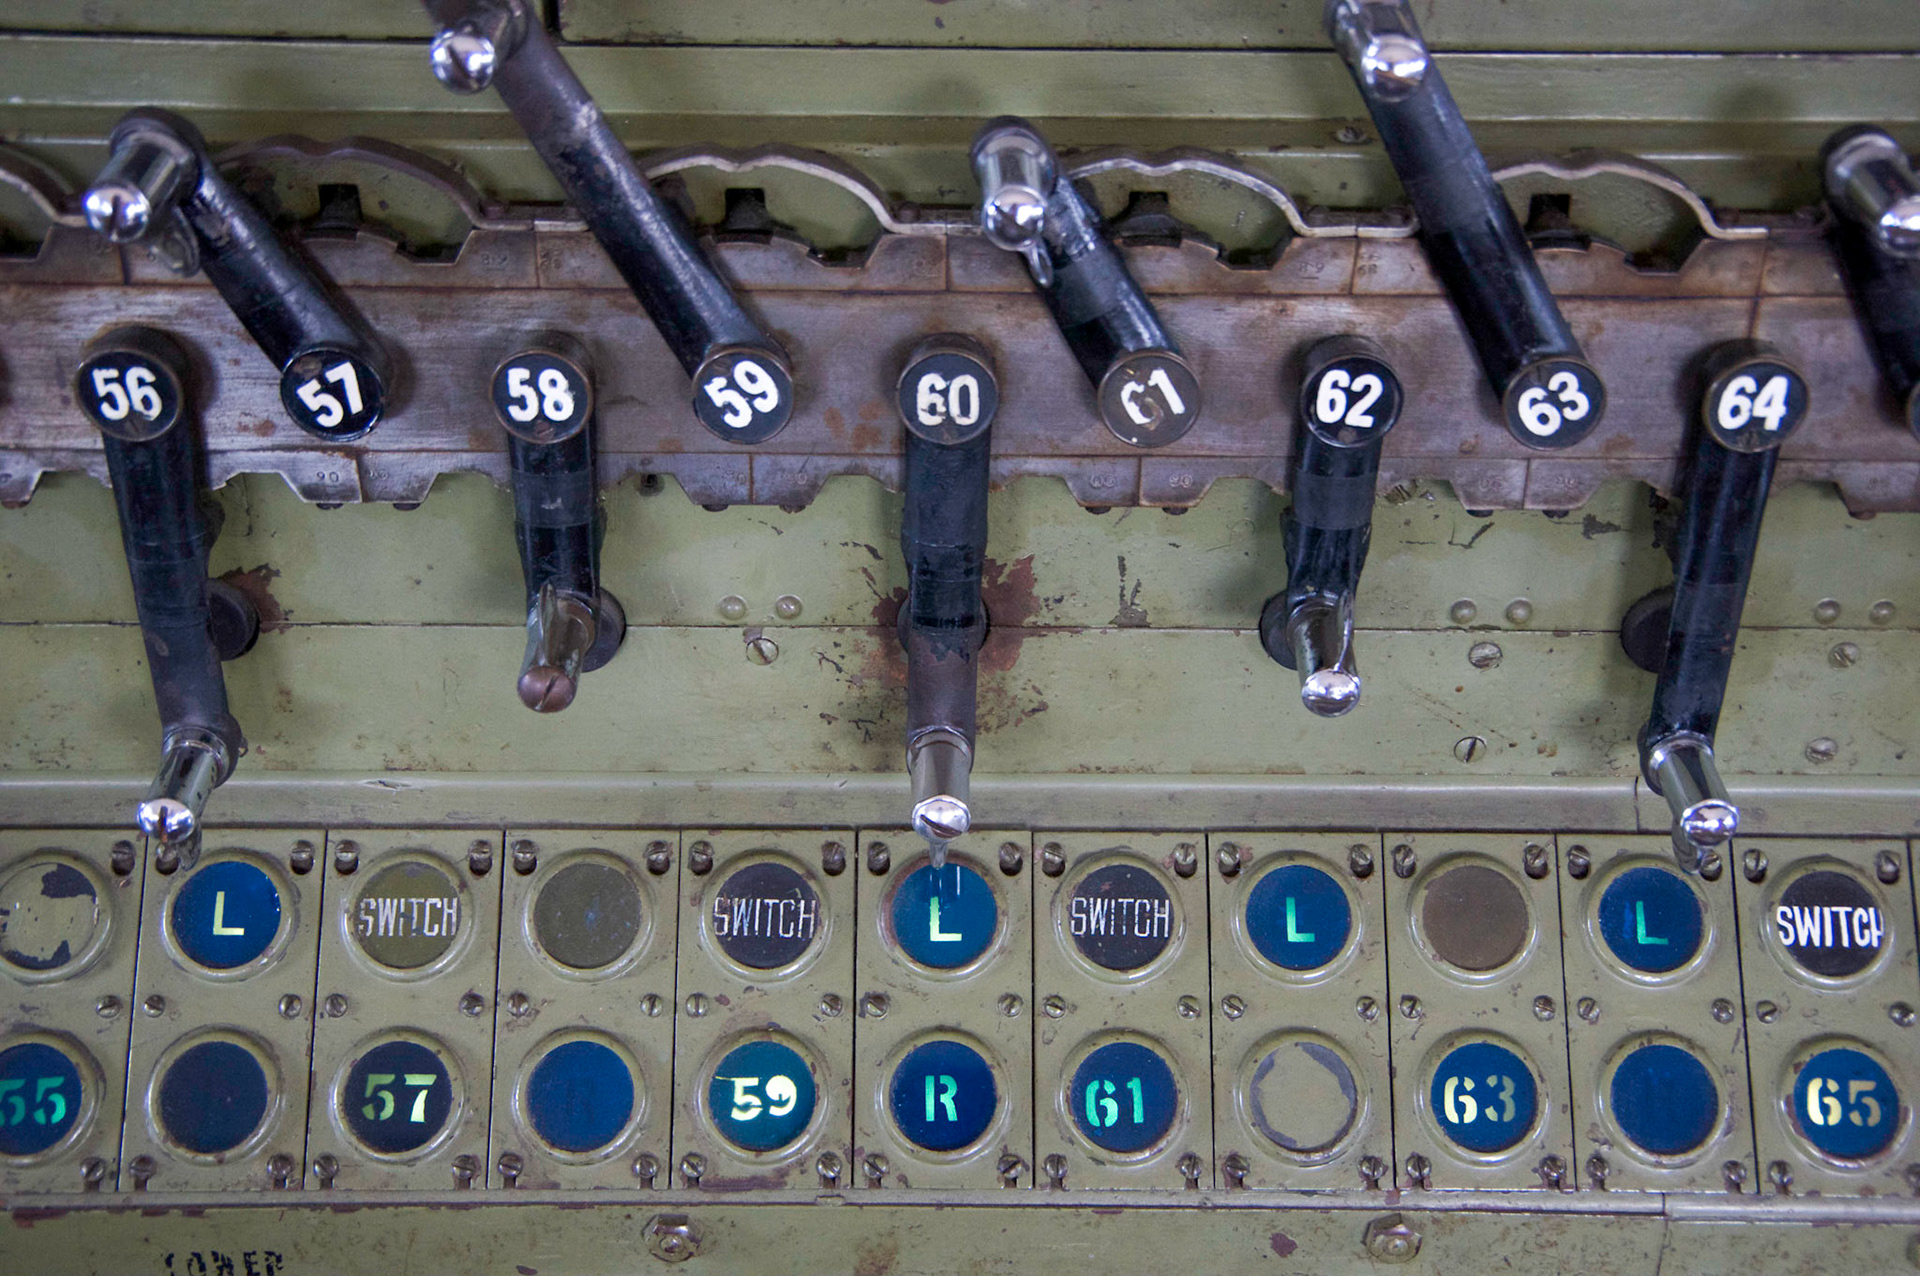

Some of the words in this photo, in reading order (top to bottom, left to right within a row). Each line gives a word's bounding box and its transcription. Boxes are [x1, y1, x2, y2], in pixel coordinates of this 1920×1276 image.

[93, 367, 162, 421] 56
[297, 361, 363, 427] 57
[507, 367, 575, 422] 58
[704, 361, 779, 428] 59
[916, 372, 980, 426] 60
[1120, 368, 1186, 425] 61
[1316, 369, 1384, 428] 62
[1518, 372, 1590, 437] 63
[1717, 375, 1789, 431] 64
[212, 891, 245, 936] L
[359, 897, 458, 937] SWITCH
[713, 896, 817, 939] SWITCH
[929, 896, 962, 942] L
[1070, 896, 1171, 938] SWITCH
[1286, 897, 1315, 943] L
[1635, 900, 1668, 945] L
[1776, 905, 1885, 949] SWITCH
[0, 1076, 66, 1125] 55
[361, 1073, 437, 1123] 57
[730, 1074, 798, 1122] 59
[925, 1074, 958, 1122] R
[1085, 1077, 1144, 1128] 61
[1444, 1076, 1516, 1124] 63
[1806, 1077, 1882, 1126] 65
